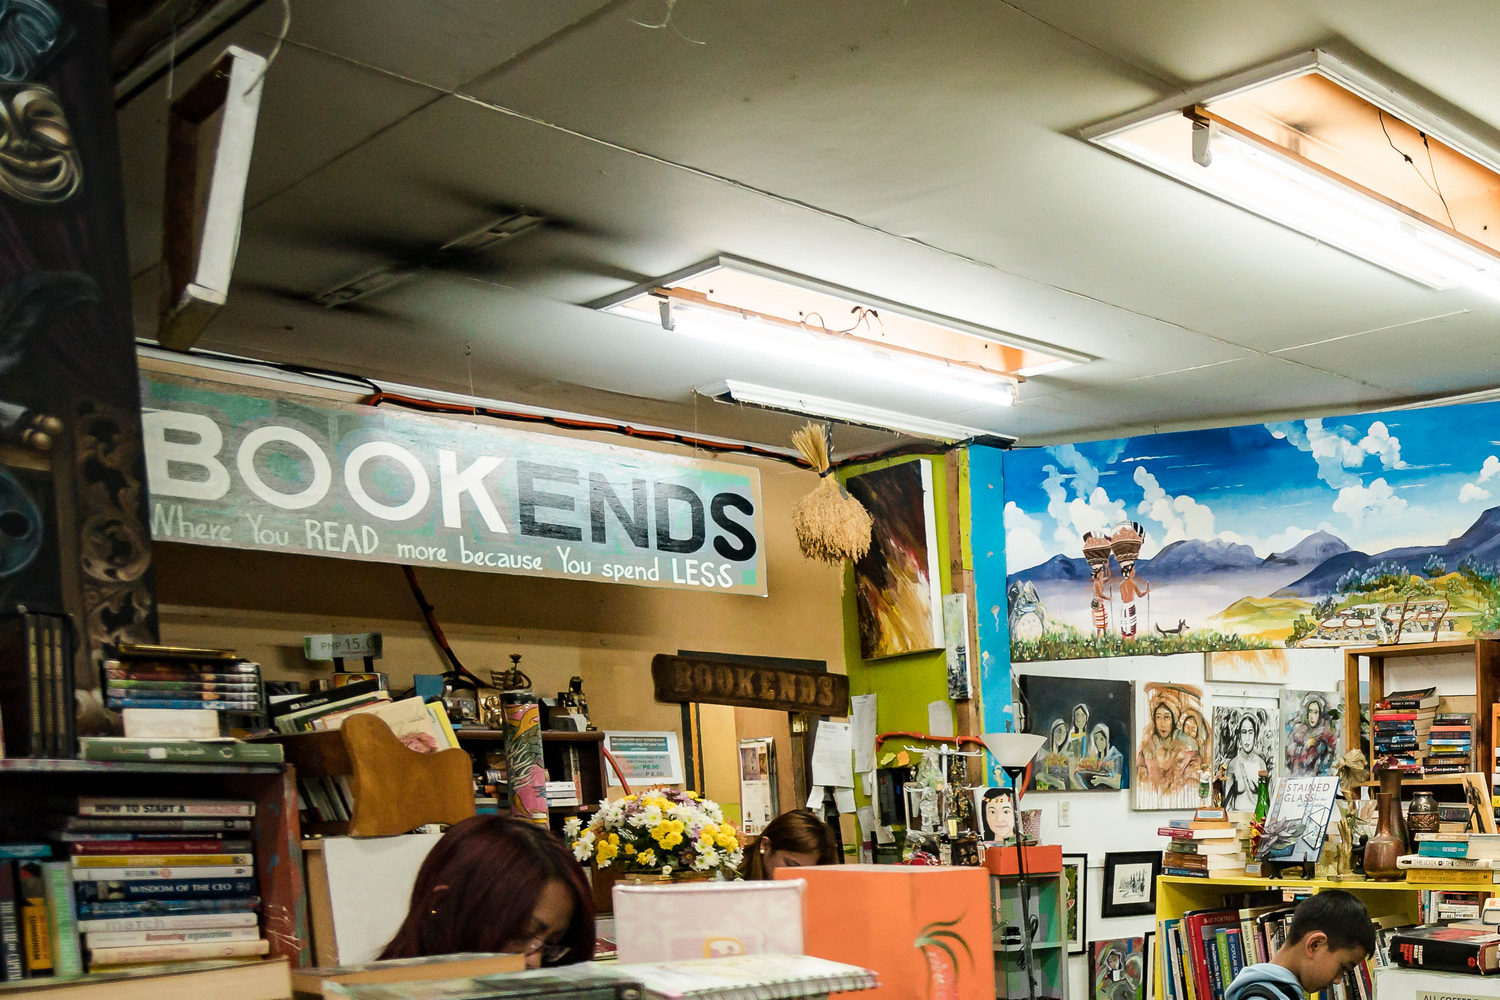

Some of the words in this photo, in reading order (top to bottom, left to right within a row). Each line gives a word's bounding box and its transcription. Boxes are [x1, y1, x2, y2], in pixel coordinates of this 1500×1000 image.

[141, 407, 757, 561] BOOKENDS
[152, 504, 233, 541] Where
[246, 512, 290, 546] You
[305, 519, 379, 554] READ
[397, 543, 448, 563] more
[459, 536, 544, 571] because
[556, 546, 592, 576] You
[601, 561, 660, 582] spend
[671, 558, 734, 588] LESS
[673, 662, 834, 706] BOOKENDS
[1284, 793, 1314, 803] GLASS
[1285, 783, 1331, 792] STAINED
